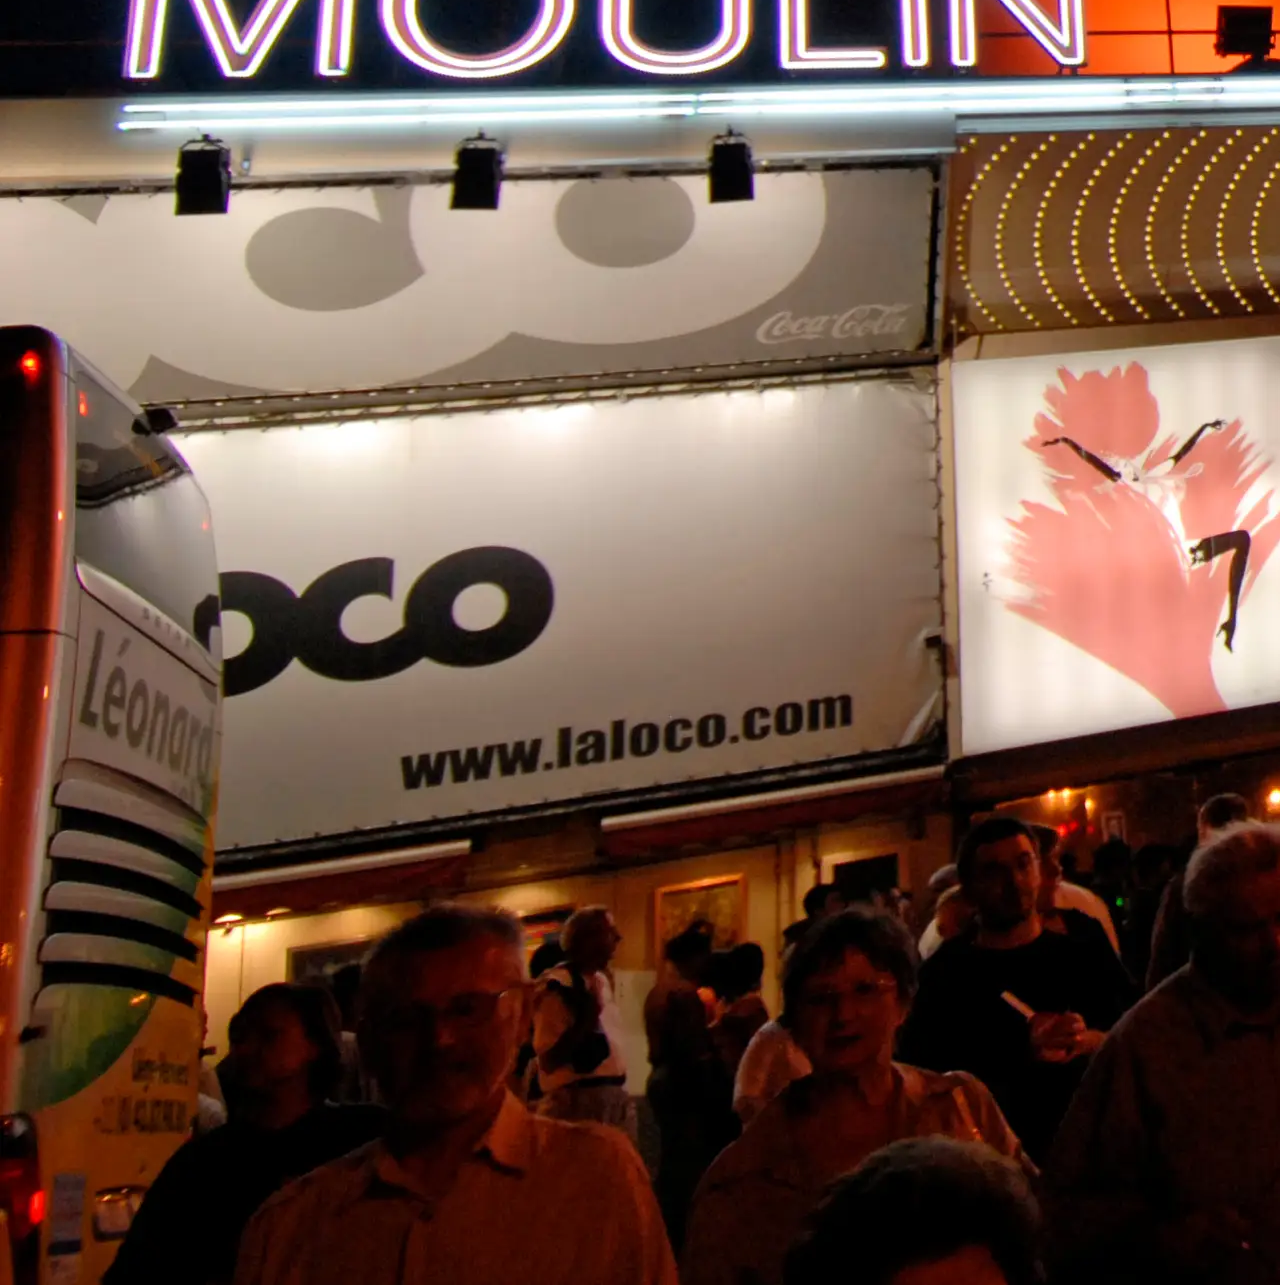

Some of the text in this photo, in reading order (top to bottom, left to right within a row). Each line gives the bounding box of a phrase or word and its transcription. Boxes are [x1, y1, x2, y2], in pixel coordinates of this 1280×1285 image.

[755, 302, 912, 345] Coca-Cola
[79, 626, 215, 790] Léonard
[400, 693, 854, 791] www.laloco.com
